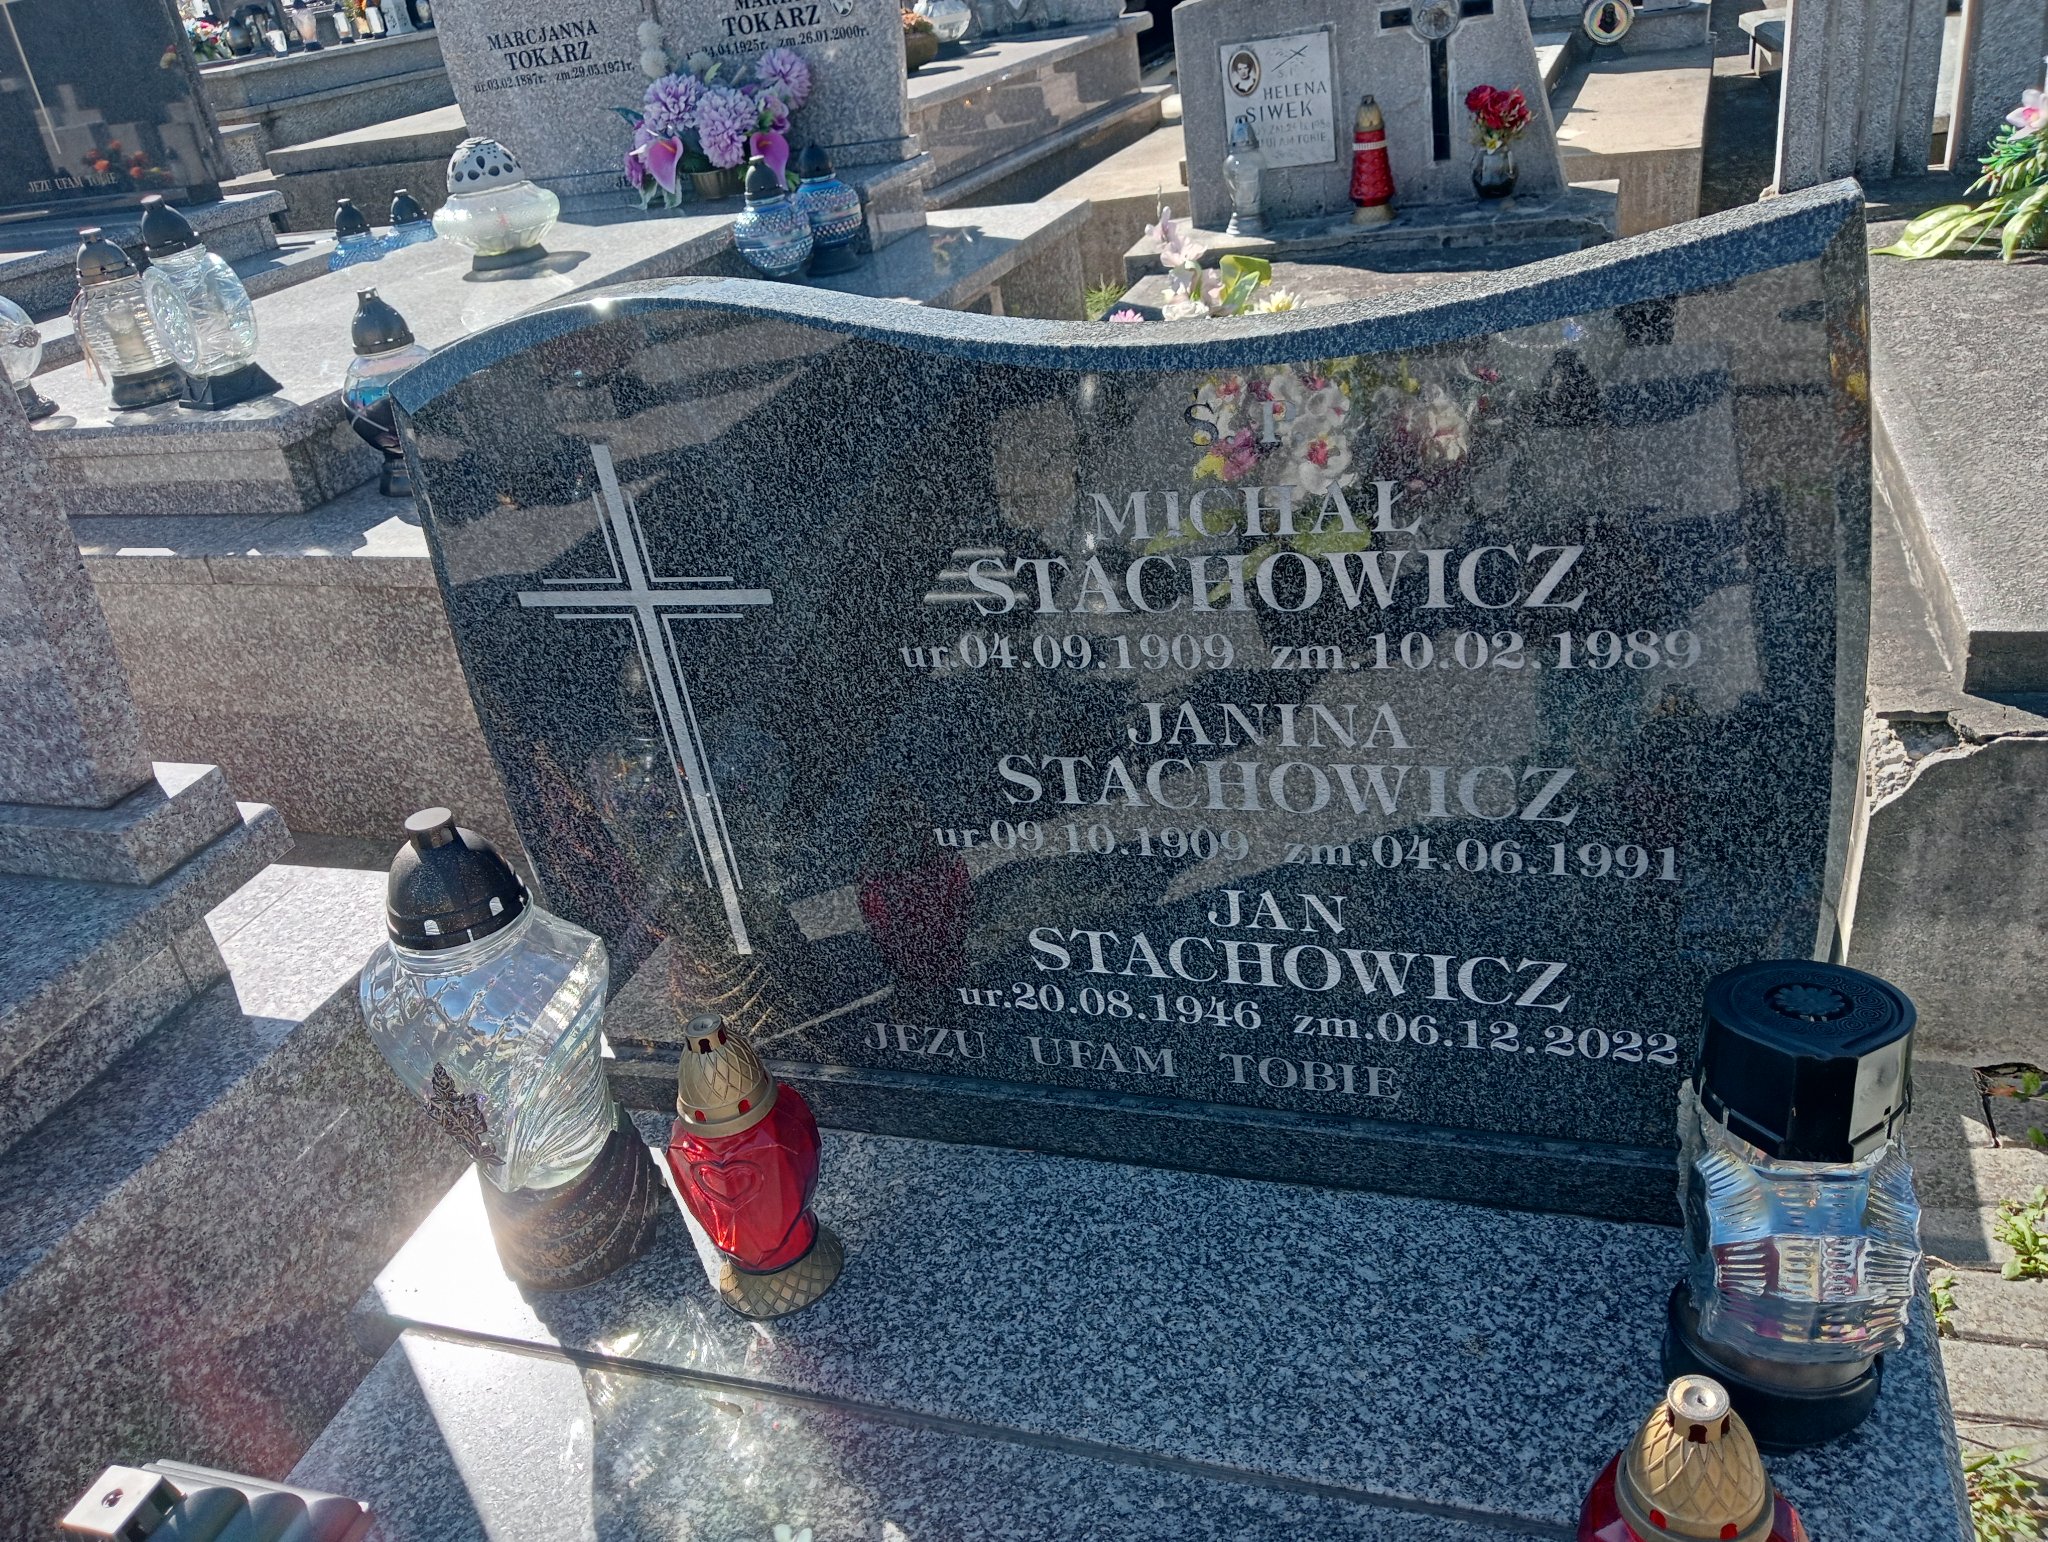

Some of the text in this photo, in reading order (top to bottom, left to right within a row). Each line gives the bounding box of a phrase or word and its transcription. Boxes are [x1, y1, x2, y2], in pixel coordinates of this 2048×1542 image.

[487, 19, 599, 51] MARCJANNA
[722, 4, 821, 37] TOKARZ
[778, 25, 870, 48] zm.26.01.2000r.
[504, 40, 592, 71] TOKARZ
[474, 73, 547, 93] ur.03.02.1887r.
[1263, 80, 1327, 100] HELENA
[1245, 99, 1313, 123] SIWEK
[1087, 480, 1422, 540] MICHAŁ
[967, 545, 1589, 616] STACHOWICZ
[899, 629, 1699, 670] ur.04.09.1909 zm.10.02.1989
[1128, 700, 1414, 748] JANINA
[998, 754, 1580, 826] STACHOWICZ
[1283, 834, 1680, 881] zm.04.06.1991
[1208, 889, 1347, 935] JAN
[1028, 927, 1572, 1013] STACHOWICZ
[957, 981, 1678, 1065] ur.20.08.1946 zm.06.12.2022
[864, 1022, 1401, 1100] JEZU UFAM TOBIE
